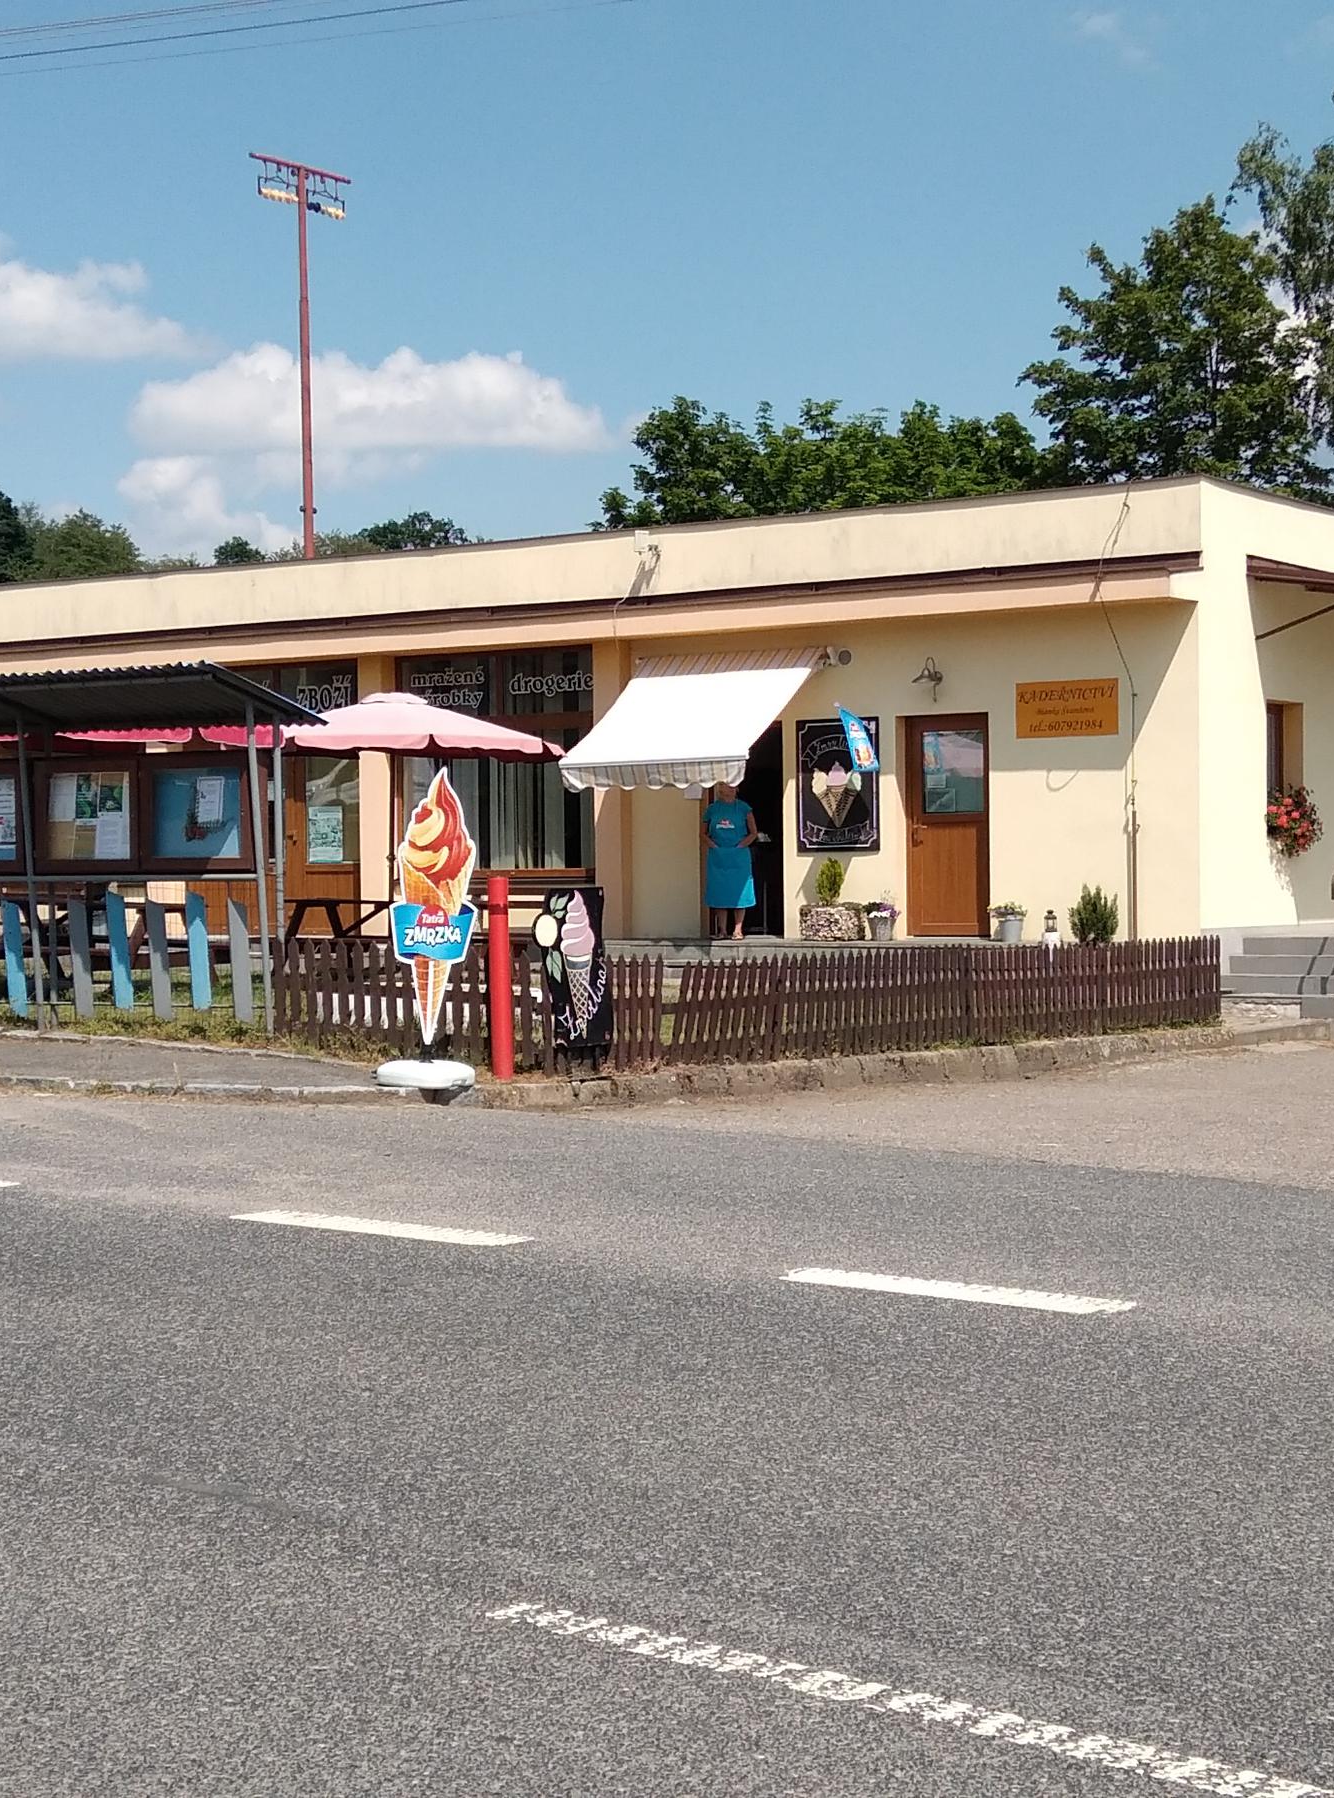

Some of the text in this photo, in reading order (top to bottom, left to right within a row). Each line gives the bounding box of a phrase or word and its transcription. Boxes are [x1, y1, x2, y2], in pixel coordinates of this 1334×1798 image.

[410, 666, 485, 688] mražené
[509, 670, 594, 698] drogerie
[296, 675, 352, 713] ZBOŽÍ
[403, 926, 462, 947] ZMRZKA
